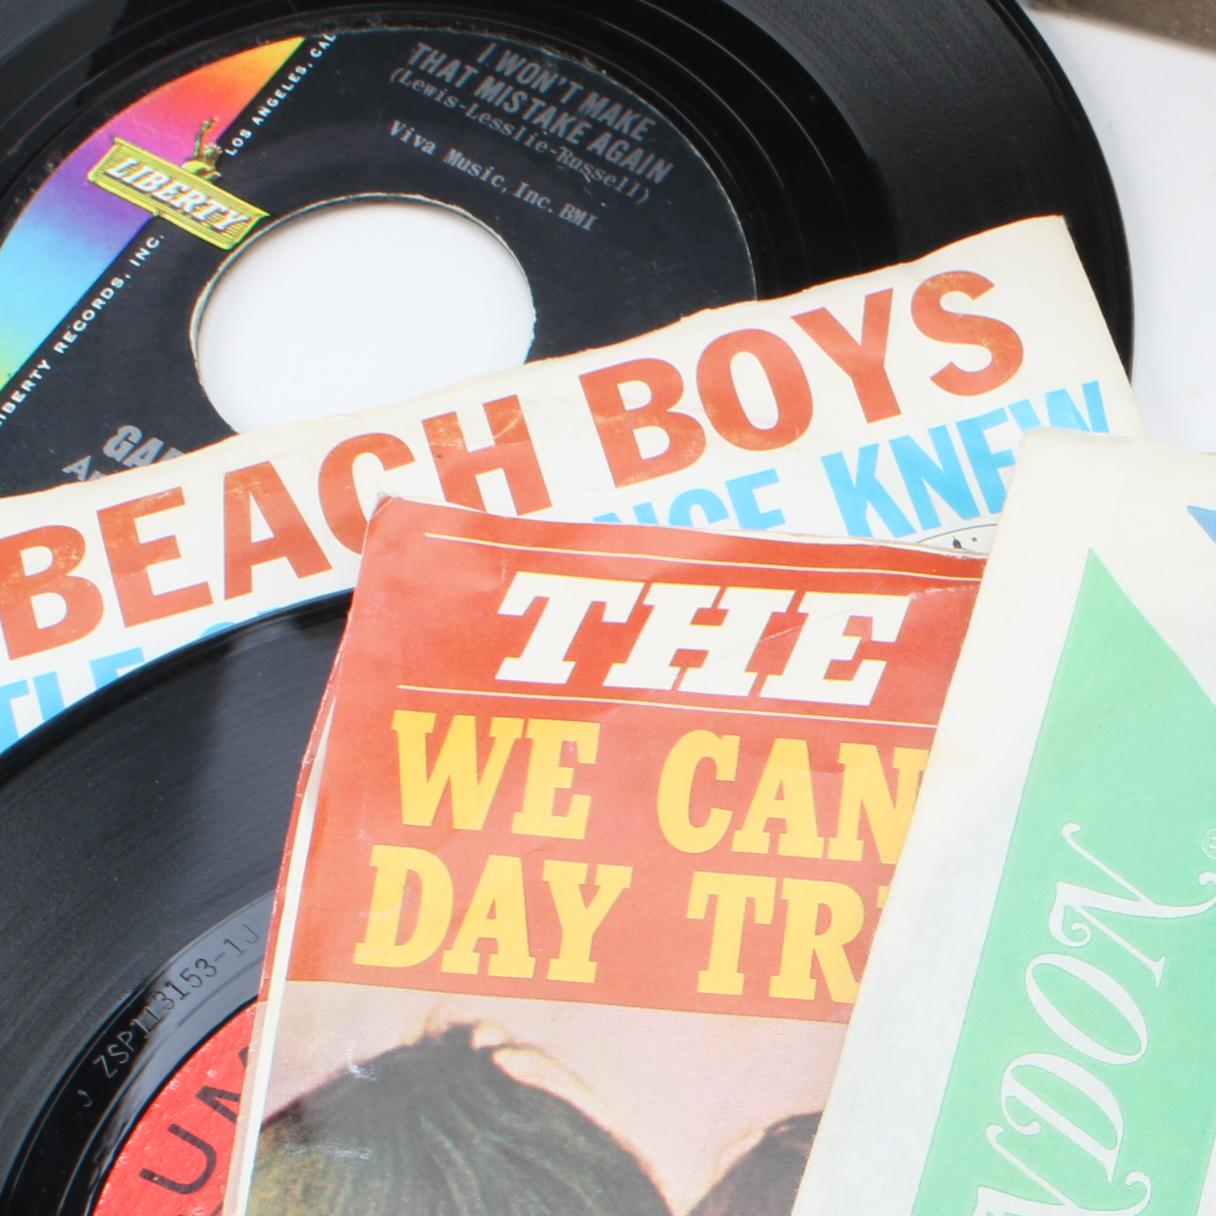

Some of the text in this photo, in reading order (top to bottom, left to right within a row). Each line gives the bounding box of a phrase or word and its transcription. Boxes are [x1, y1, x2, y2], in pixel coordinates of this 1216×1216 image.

[225, 128, 252, 156] LOS
[252, 63, 313, 126] ANGELES,
[390, 68, 650, 202] (Lewis-Lesslie-Russell)
[407, 42, 674, 185] THAT MISTAKE AGAIN
[477, 43, 657, 142] I WON'T MAKE
[106, 157, 249, 231] LIBERTY
[389, 119, 599, 231] Viva Music, Inc. BMI
[0, 233, 164, 426] IBERTY RECORDS, INC.
[0, 269, 1025, 661] BEACH BOYS
[495, 571, 911, 706] THE
[391, 709, 931, 866] WE CAN
[353, 844, 890, 1004] DAY TR
